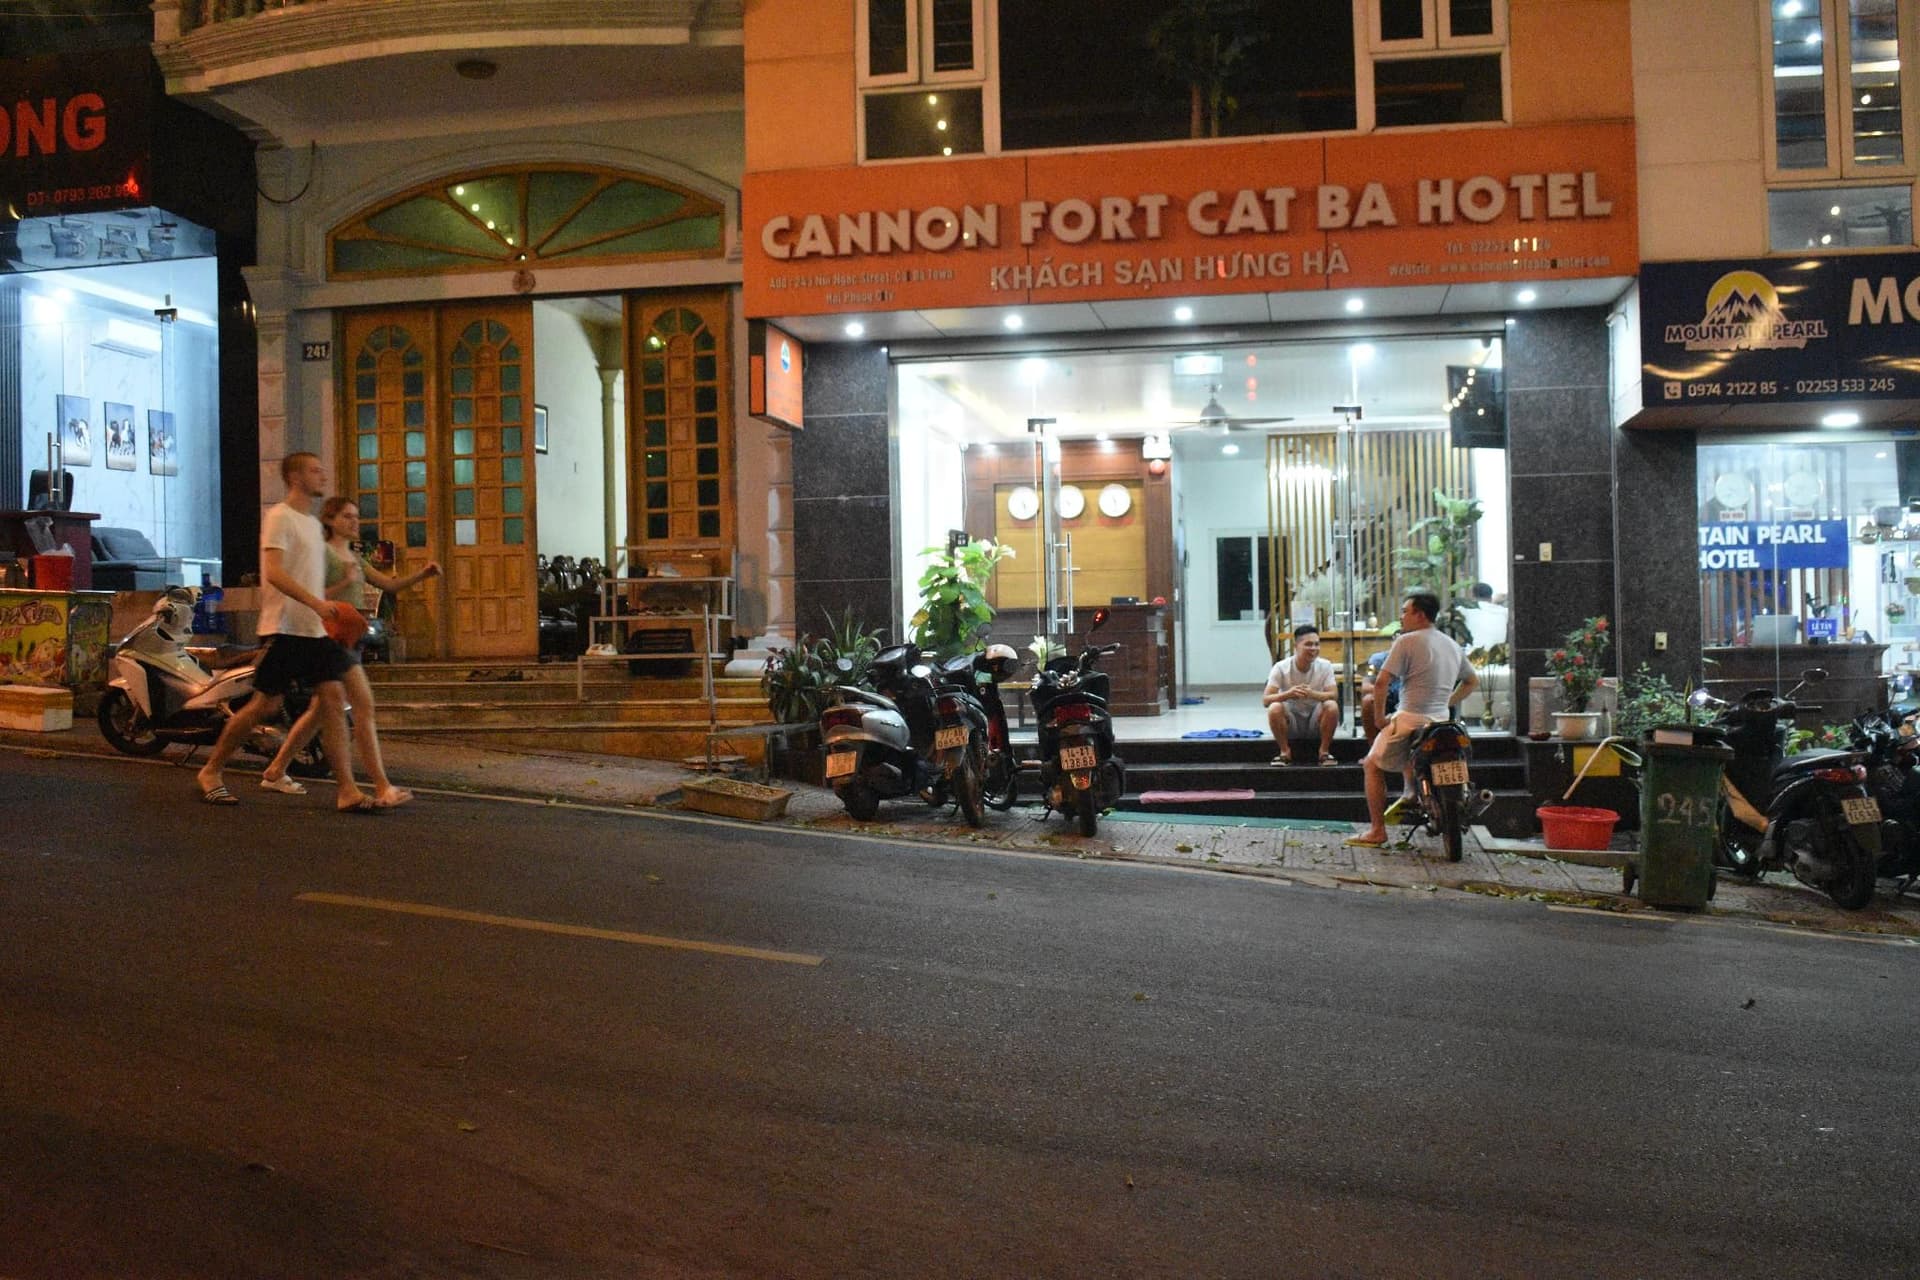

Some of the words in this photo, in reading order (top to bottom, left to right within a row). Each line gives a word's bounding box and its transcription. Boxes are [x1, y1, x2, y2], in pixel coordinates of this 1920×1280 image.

[0, 93, 107, 158] NG
[761, 203, 999, 260] CANNON
[1020, 193, 1169, 246] FORT
[1187, 185, 1296, 236] CAT
[1316, 181, 1398, 231] BA
[1418, 170, 1612, 225] HOTEL
[990, 257, 1103, 291] KHÁCH
[1114, 257, 1182, 292] SẠN
[1194, 249, 1290, 281] HƯNG
[1303, 242, 1350, 276] HÀ
[1848, 276, 1920, 326] M
[1771, 319, 1828, 340] PEARL
[305, 344, 328, 360] 241
[1688, 382, 1721, 398] 0974
[1726, 381, 1757, 396] 2122
[1760, 381, 1777, 395] 85
[1796, 380, 1838, 394] 02253
[1841, 378, 1865, 393] 533
[1869, 377, 1896, 393] 245
[1757, 524, 1827, 545] PEARL
